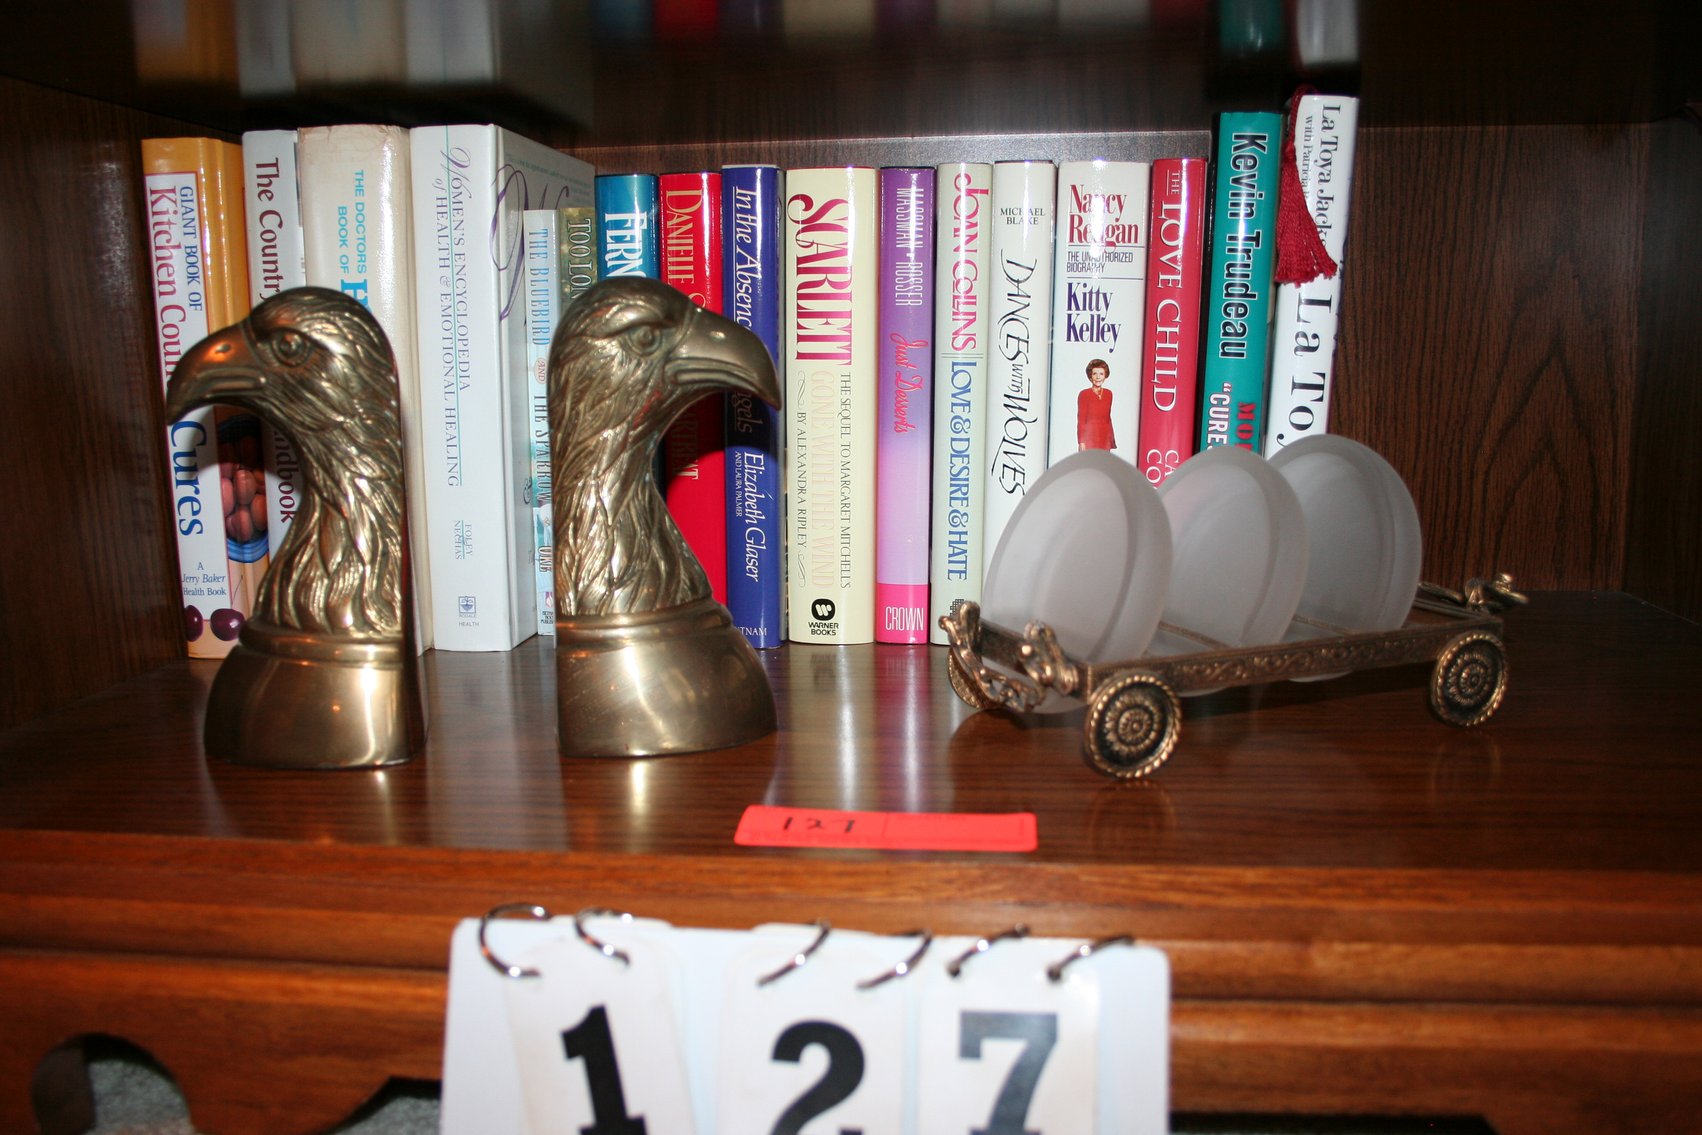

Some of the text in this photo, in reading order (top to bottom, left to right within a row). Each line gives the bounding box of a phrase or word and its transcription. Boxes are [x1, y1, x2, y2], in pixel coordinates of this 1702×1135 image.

[1321, 104, 1341, 132] La
[1170, 170, 1181, 195] THE
[1314, 135, 1339, 184] Toya
[150, 186, 181, 298] Kitchen
[179, 186, 202, 312] GIANT BOOK OF
[256, 157, 284, 301] The Countr
[338, 206, 350, 274] BOOK OF
[354, 169, 367, 274] THE DOCTORS
[436, 197, 450, 268] HEALTH
[529, 228, 548, 260] THE
[568, 218, 591, 258] TOO
[665, 189, 703, 285] DANIELLE
[1068, 214, 1139, 253] Regan
[1219, 132, 1268, 359] Kevin Trudeau
[736, 186, 760, 330] In the Absenc
[787, 193, 853, 366] SCARLETT
[895, 262, 923, 306] ROSSER
[951, 173, 989, 352] JOAN COLLINS
[1067, 251, 1080, 262] THE
[454, 253, 470, 391] ENCYCLOPEDIA
[529, 269, 550, 345] BLUEBIRD
[998, 249, 1037, 364] DANCES
[1066, 282, 1113, 322] Kitty
[1066, 313, 1122, 354] Kelley
[1153, 200, 1184, 412] LOVE CHILD
[441, 293, 455, 401] EMOTIONAL
[1276, 294, 1333, 447] La To
[840, 372, 851, 395] THE
[445, 408, 459, 487] HEALING
[837, 398, 851, 439] SEQUEL
[840, 442, 851, 458] TO
[992, 378, 1038, 495] WOLVES
[170, 420, 207, 536] Cures
[275, 431, 299, 523] ndbook
[734, 451, 742, 466] AND
[797, 412, 807, 548] BY ALEXANDRA RIPLEY
[840, 461, 851, 523] MARGARET
[947, 361, 977, 581] LOVE & DESIRE & HATE
[735, 491, 743, 517] PALMER
[744, 452, 766, 582] Elizabeth Glaser
[182, 574, 226, 585] Jerry Baker
[184, 587, 227, 596] Health Book
[197, 562, 204, 571] A
[737, 626, 767, 636] TNAM
[808, 621, 839, 629] WARNER
[885, 606, 924, 631] CROWN
[783, 816, 855, 833] 127
